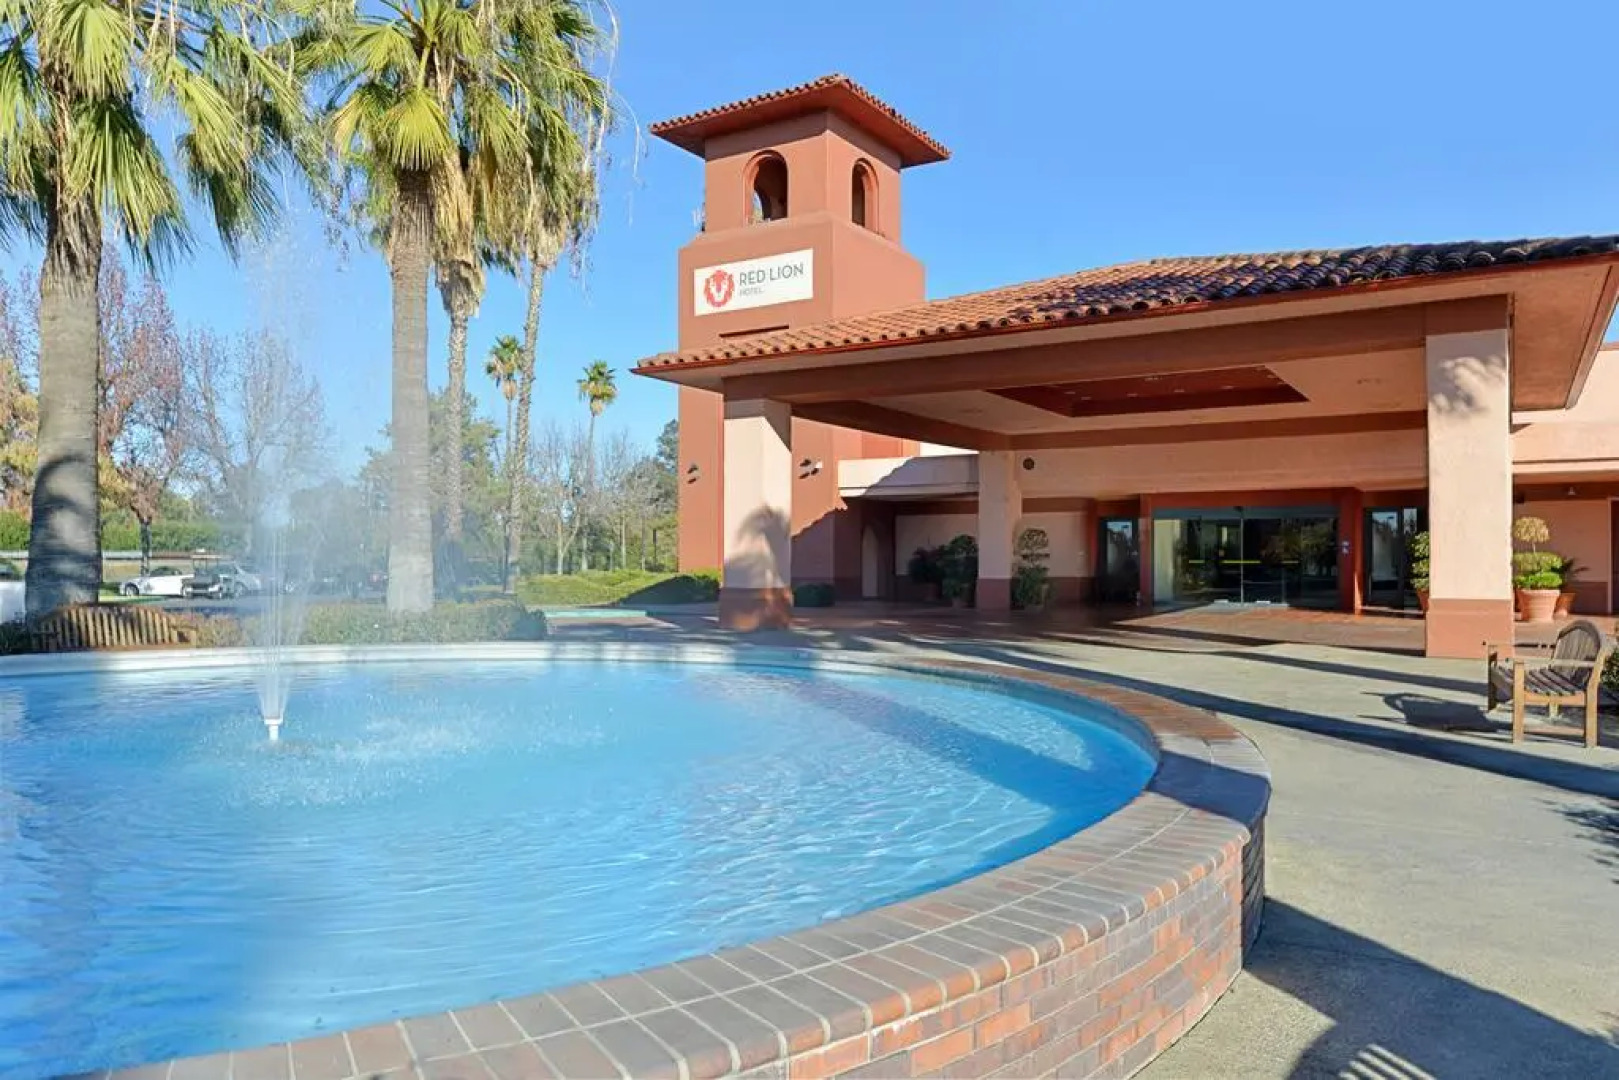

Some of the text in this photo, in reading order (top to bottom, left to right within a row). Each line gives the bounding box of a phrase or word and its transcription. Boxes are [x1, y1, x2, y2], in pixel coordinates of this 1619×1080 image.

[739, 262, 804, 286] RED LION
[739, 286, 764, 296] HOTEL
